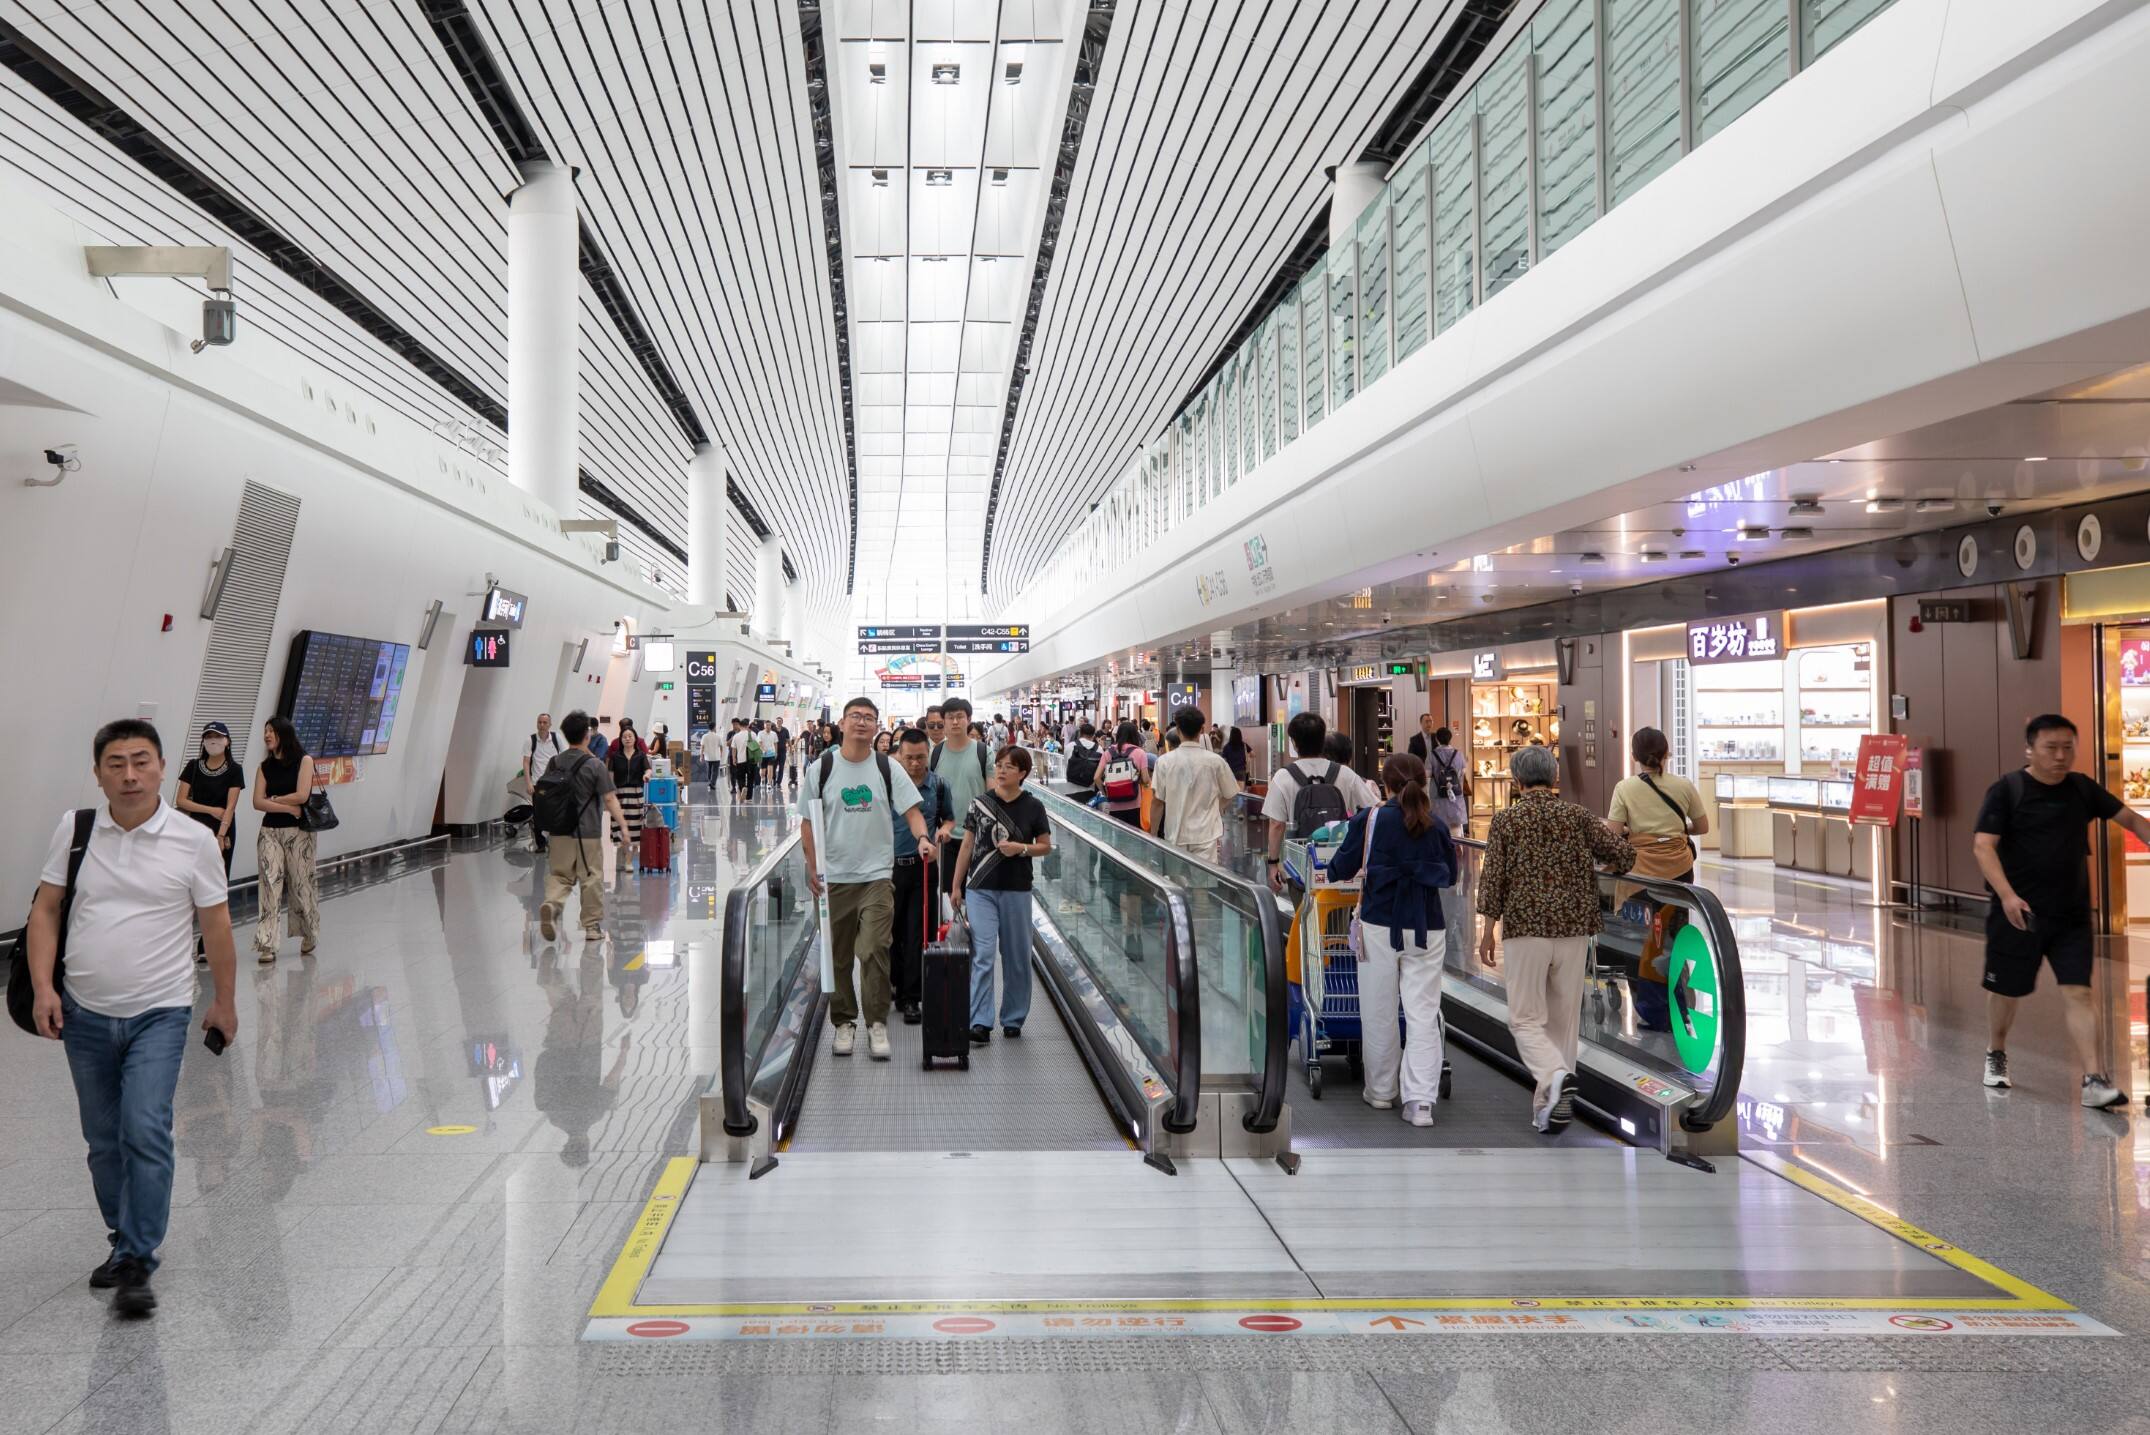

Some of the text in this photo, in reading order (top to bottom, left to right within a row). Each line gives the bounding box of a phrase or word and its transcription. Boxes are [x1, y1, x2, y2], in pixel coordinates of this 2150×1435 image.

[1689, 621, 1748, 658] 百岁坊
[688, 661, 715, 677] C56
[1170, 692, 1193, 706] C41
[1867, 755, 1894, 773] 超值
[1864, 773, 1891, 791] 满赠
[1435, 1314, 1579, 1324] 紧握扶手
